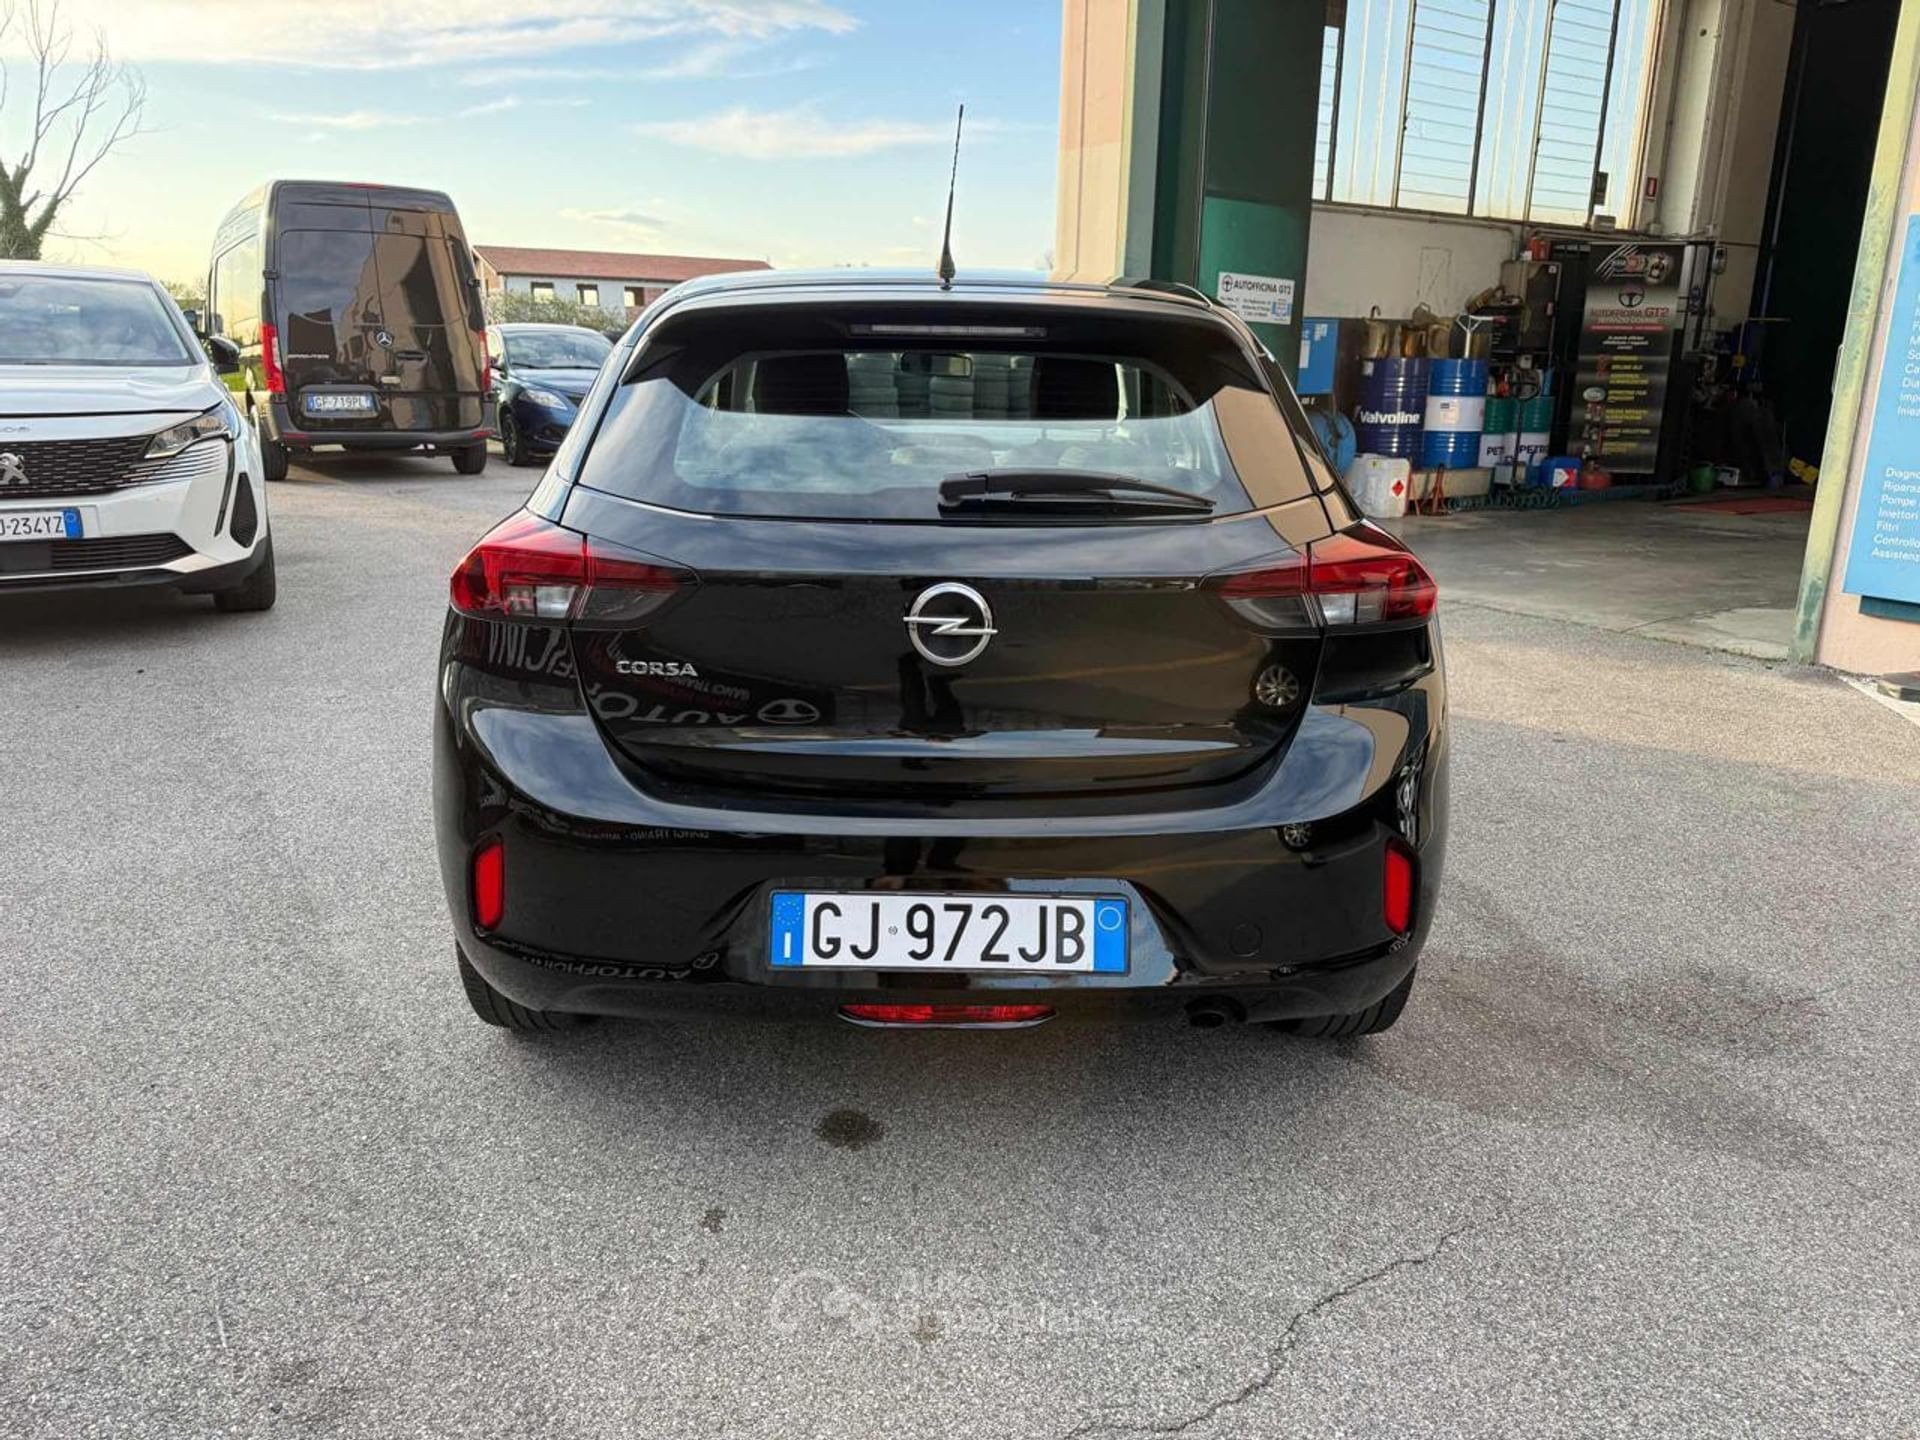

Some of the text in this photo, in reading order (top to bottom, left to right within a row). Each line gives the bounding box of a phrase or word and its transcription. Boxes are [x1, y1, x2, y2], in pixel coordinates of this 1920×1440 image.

[1234, 279, 1277, 292] AUTOFFICINA
[1360, 411, 1420, 424] Valvoline
[11, 515, 64, 536] 234YZ
[615, 660, 699, 678] CORSA
[811, 901, 1086, 964] GJ 972JB
